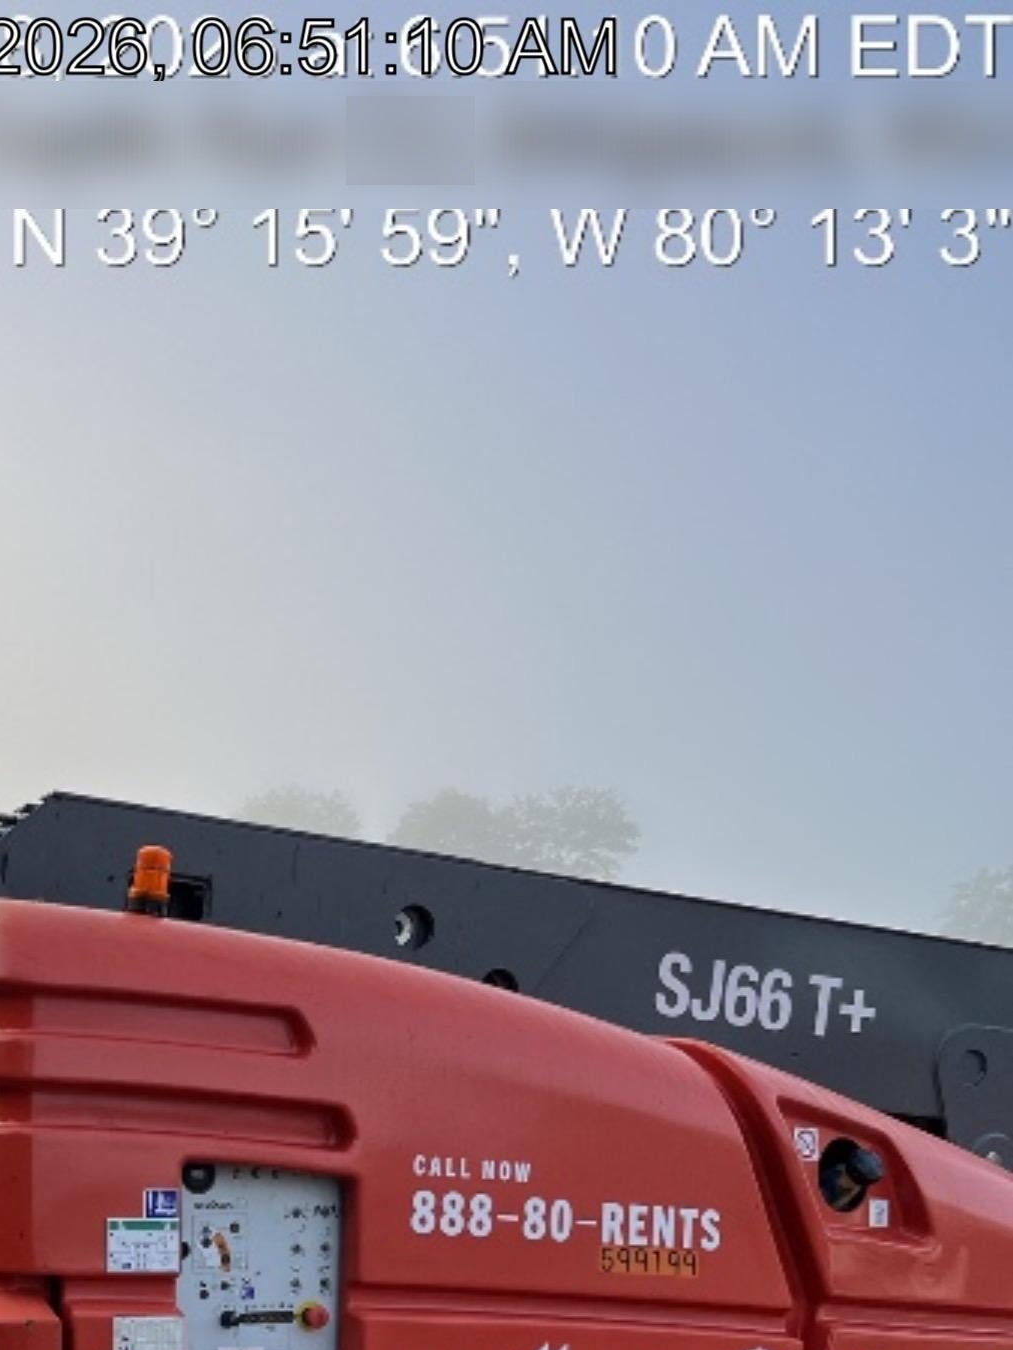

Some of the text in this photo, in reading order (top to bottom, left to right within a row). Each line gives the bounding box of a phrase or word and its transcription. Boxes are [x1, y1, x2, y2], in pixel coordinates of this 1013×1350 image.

[655, 951, 876, 1036] SJ66 T+
[412, 1154, 531, 1182] CALL NOW
[410, 1190, 721, 1251] 888-80-RENTS
